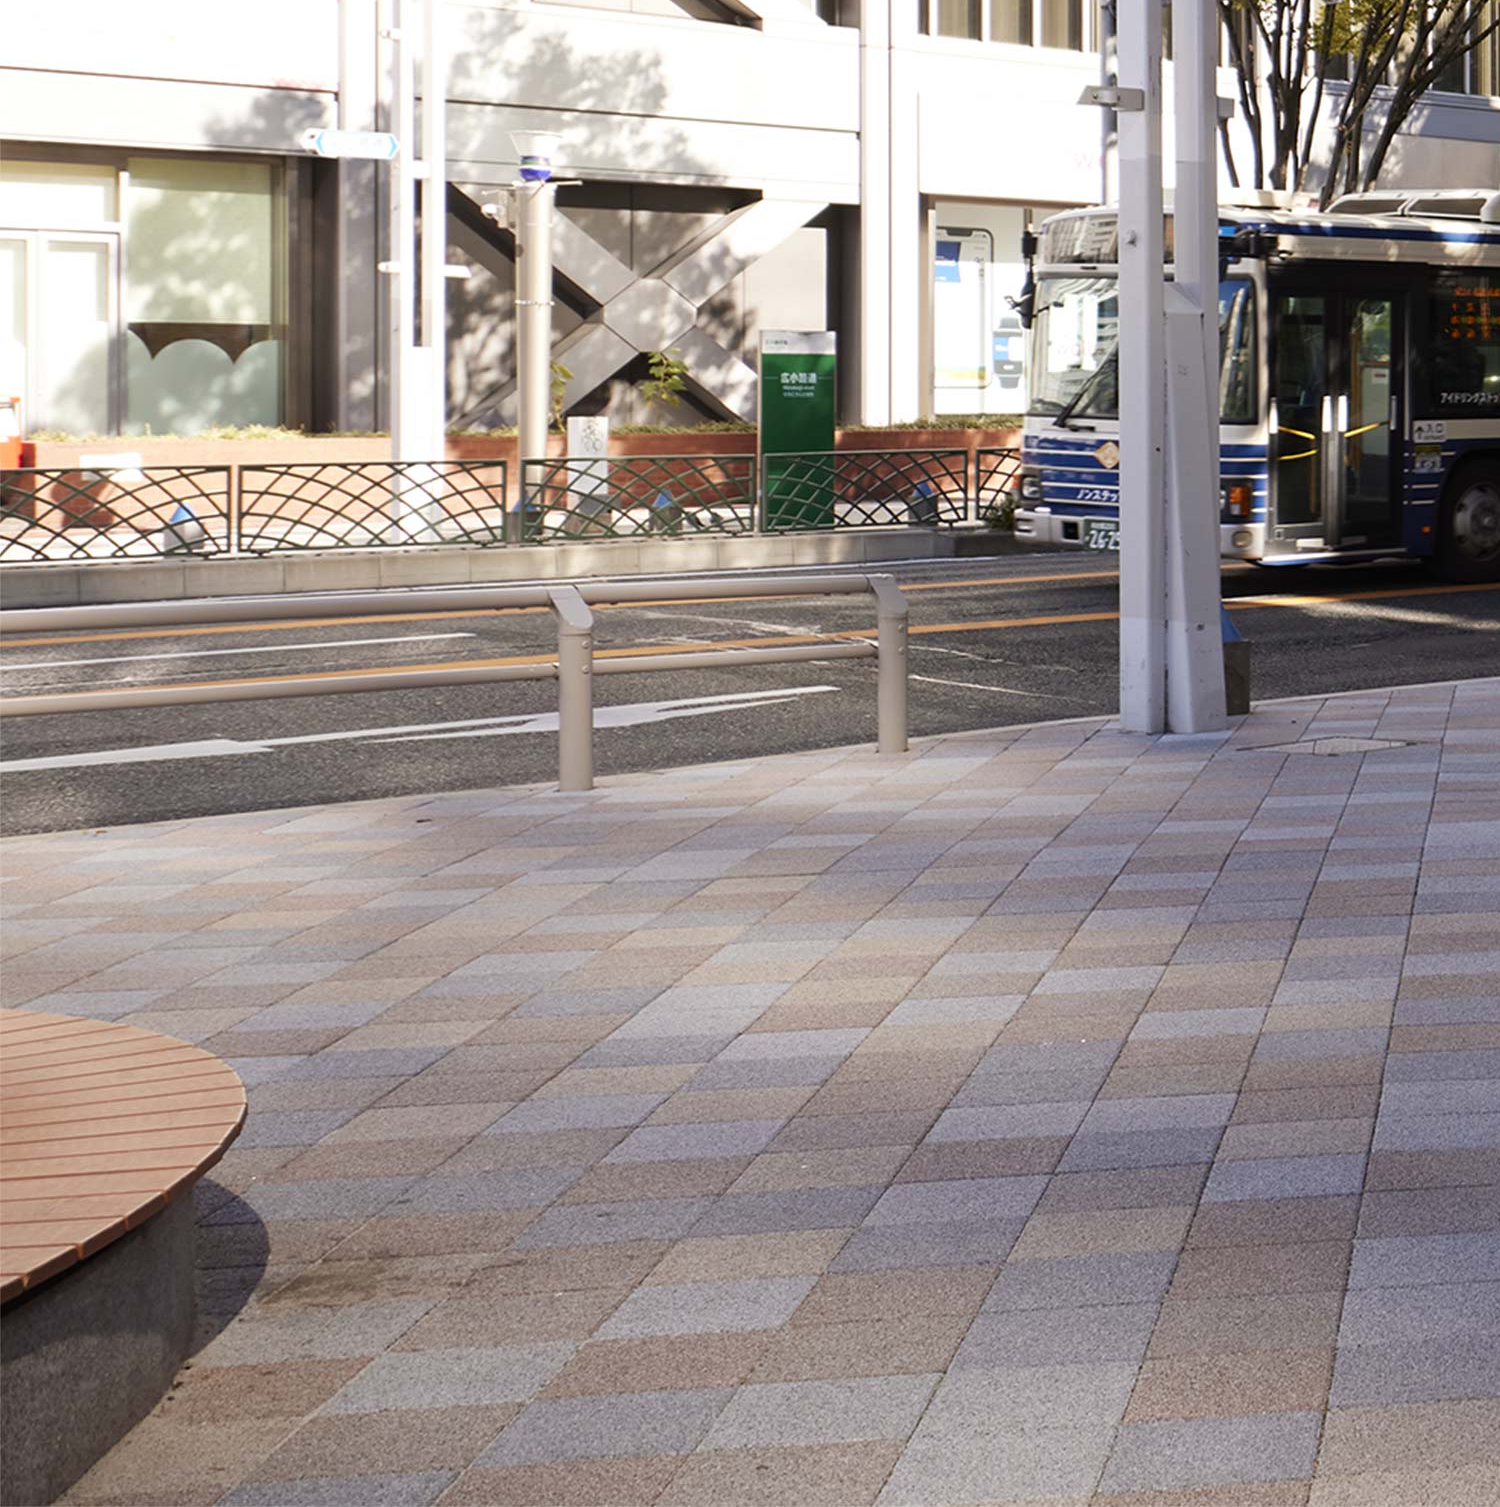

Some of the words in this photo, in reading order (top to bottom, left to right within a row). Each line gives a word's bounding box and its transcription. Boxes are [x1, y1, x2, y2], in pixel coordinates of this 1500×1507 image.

[1076, 488, 1120, 502] ノンステッ
